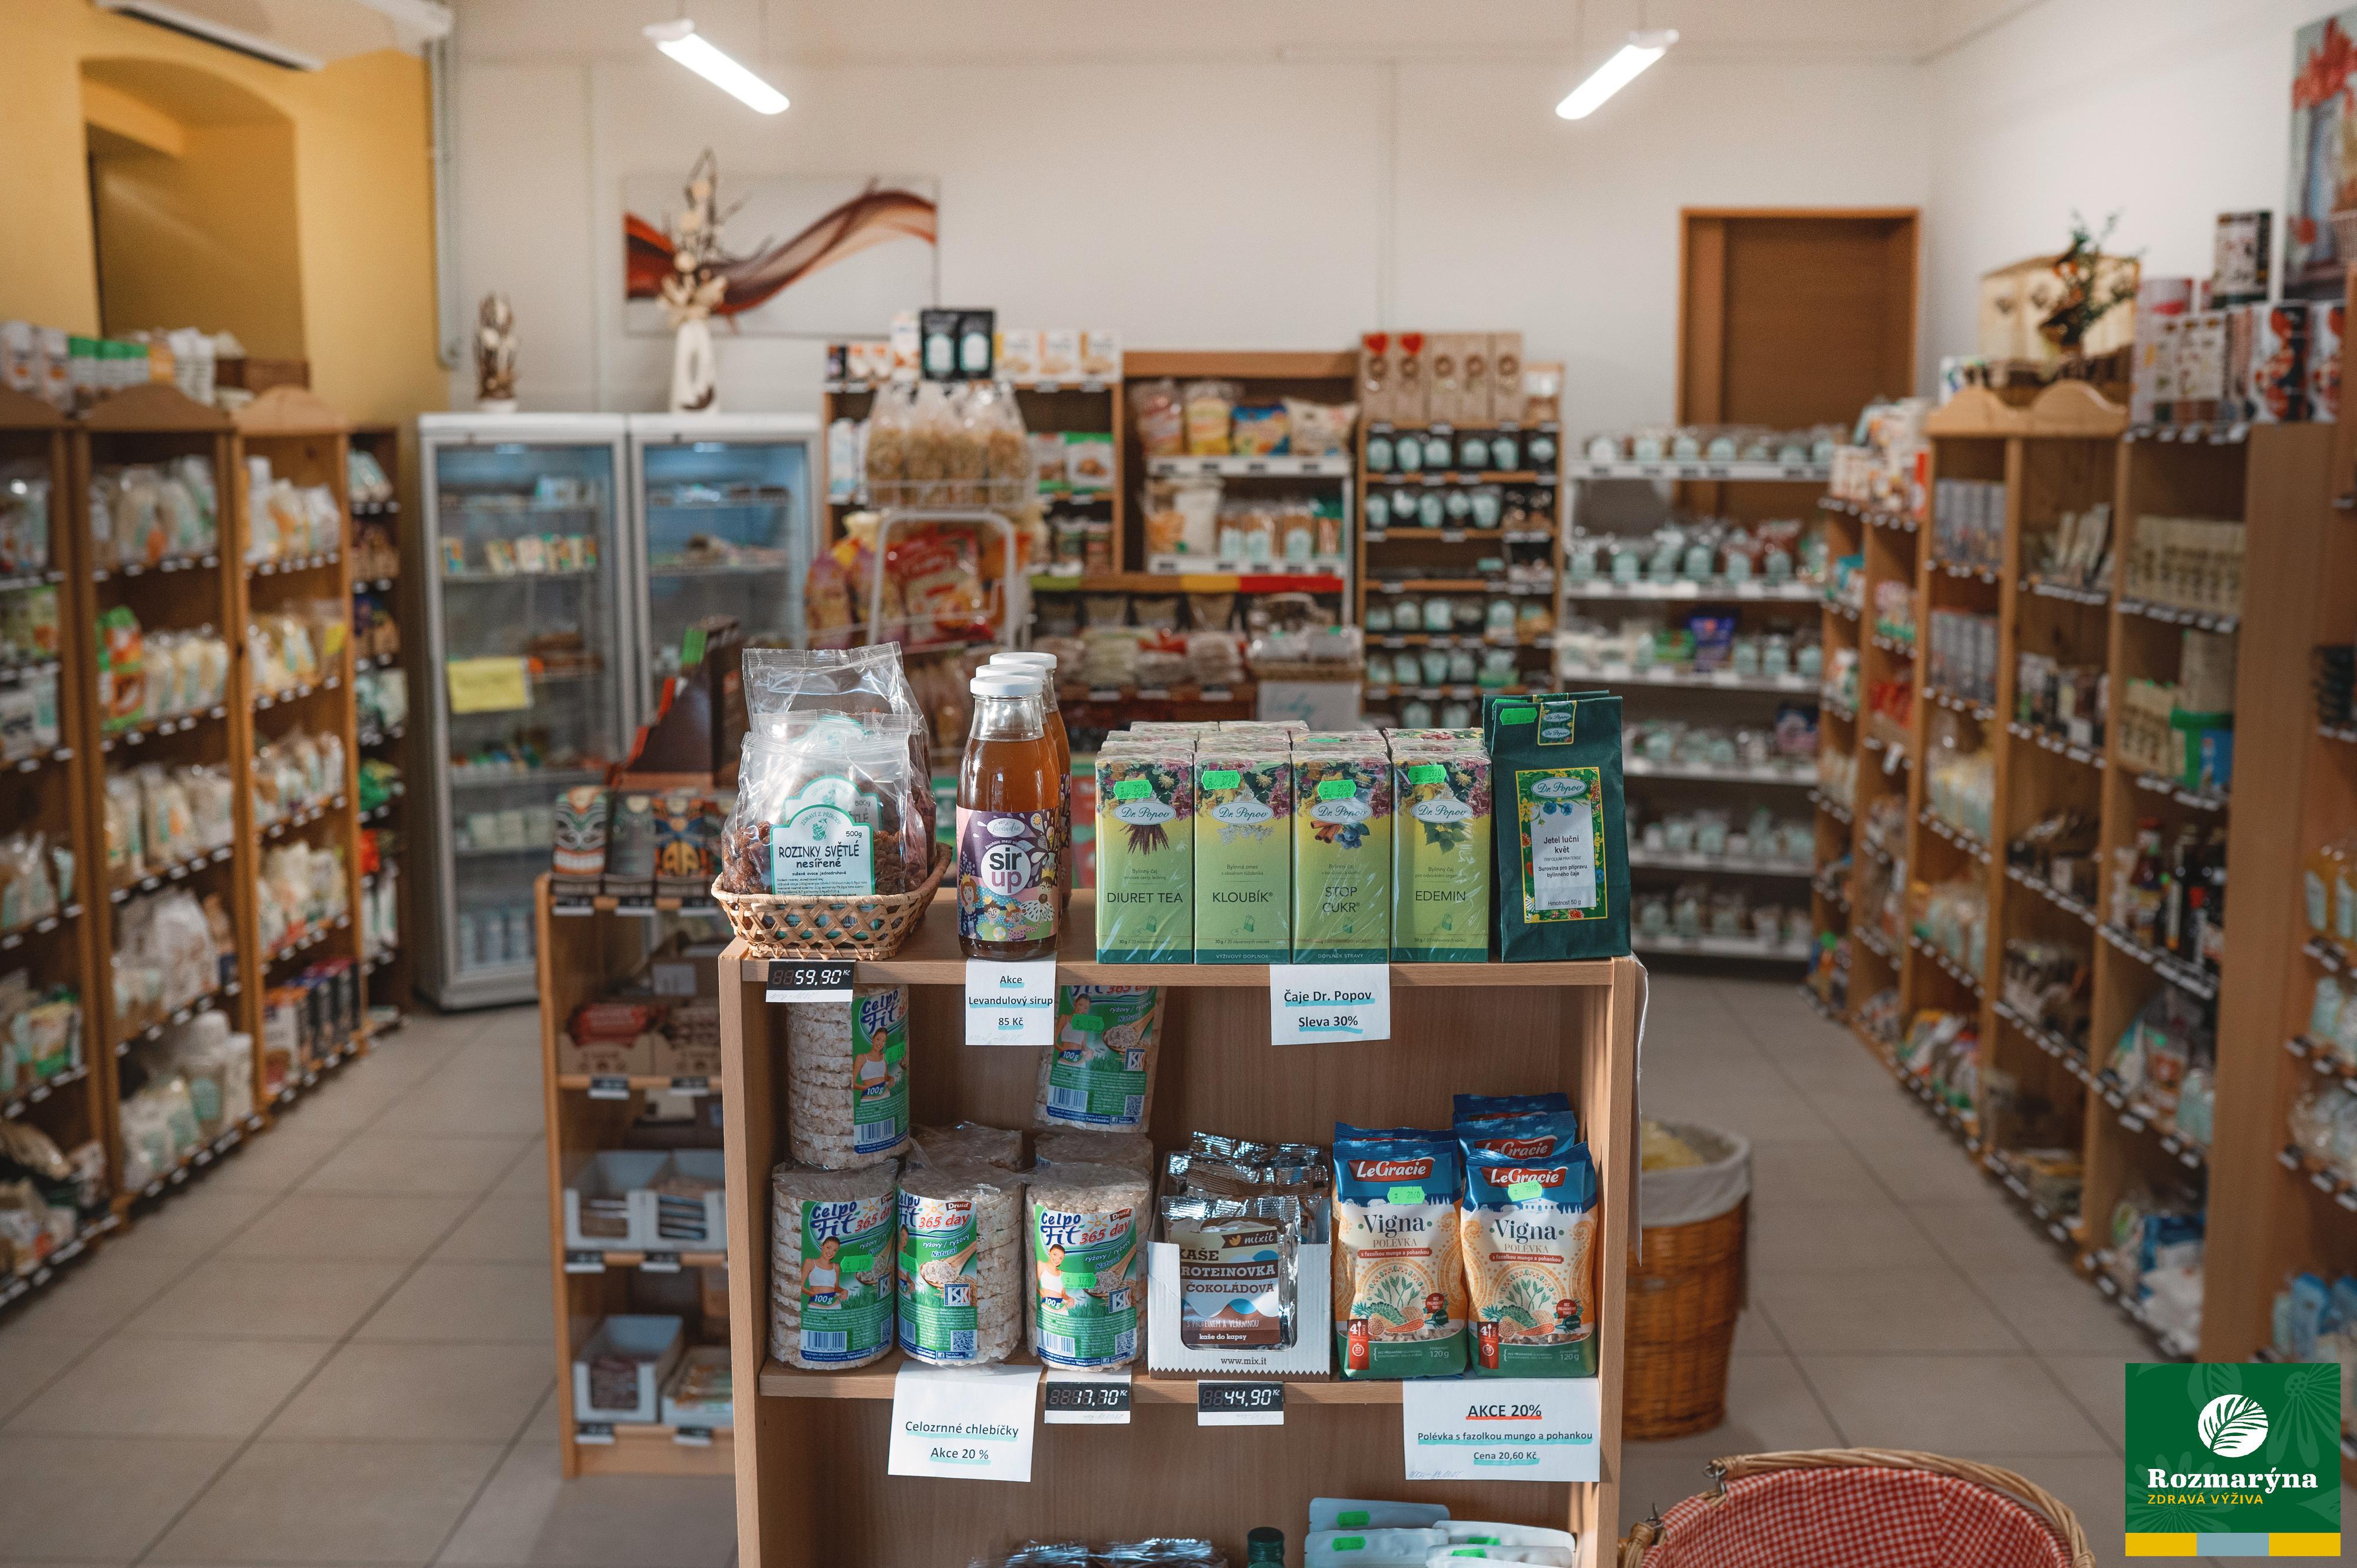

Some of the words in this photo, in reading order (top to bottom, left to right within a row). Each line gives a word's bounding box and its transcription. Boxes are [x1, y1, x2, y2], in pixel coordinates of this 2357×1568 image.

[1537, 783, 1550, 793] Dr.
[1553, 781, 1582, 794] Popov
[1121, 807, 1135, 818] Dr.
[1139, 807, 1170, 821] Popov
[1219, 807, 1233, 818] Dr.
[1236, 807, 1268, 821] Popov
[1318, 806, 1332, 816] Dr.
[1336, 805, 1367, 820] Popov
[1418, 805, 1432, 816] Dr.
[1435, 804, 1467, 819] Popov
[1544, 836, 1560, 844] Jetel
[1562, 834, 1579, 843] luční
[779, 846, 821, 859] ROZINKY
[825, 840, 859, 857] SVĚTLÉ
[796, 858, 841, 868] nesířené
[989, 847, 1022, 870] sir
[991, 871, 1022, 894] up
[1107, 892, 1154, 903] DIURET
[1157, 892, 1183, 903] TEA
[1325, 886, 1358, 897] STOP
[1415, 890, 1465, 901] EDEMIN
[795, 969, 842, 986] 59,90
[999, 975, 1022, 983] Akce
[969, 996, 1027, 1006] Levandulový
[1030, 996, 1053, 1006] sirup
[1284, 989, 1309, 1004] Čaje
[1313, 991, 1331, 1001] Dr.
[1334, 990, 1372, 1003] Popov
[998, 1017, 1009, 1026] 85
[1012, 1017, 1024, 1026] Kč
[1298, 1016, 1329, 1028] Sleva
[1333, 1015, 1358, 1026] 30%
[1062, 1050, 1079, 1062] 100g
[867, 1085, 884, 1095] 100g
[1356, 1161, 1427, 1178] LeGracie
[1491, 1168, 1559, 1184] LeGracie
[854, 1212, 878, 1233] 365
[918, 1216, 942, 1229] 365
[945, 1214, 971, 1227] day
[1362, 1214, 1425, 1238] Vigna
[1080, 1228, 1107, 1246] 365
[1110, 1219, 1131, 1237] day
[1244, 1232, 1274, 1245] mixit
[1494, 1219, 1557, 1245] Vigna
[1373, 1237, 1417, 1248] POLÉVKA
[1504, 1242, 1549, 1253] POLÉVKA
[931, 1246, 958, 1258] Natural
[1181, 1265, 1276, 1277] ROTEINOVKA
[1186, 1281, 1275, 1294] ČOKOLÁDOVÁ
[814, 1294, 833, 1305] 100g
[1044, 1298, 1061, 1309] 100g
[1193, 1319, 1220, 1328] PROTEINEM
[1229, 1318, 1259, 1328] VLÁKNINOU
[1349, 1323, 1358, 1335] 4
[1480, 1326, 1488, 1336] 4
[1221, 1356, 1267, 1365] www.mix.it
[1077, 1389, 1120, 1407] 17,70
[1224, 1389, 1272, 1407] 44,90
[1467, 1404, 1506, 1417] AKCE
[1511, 1404, 1542, 1417] 20%
[905, 1421, 962, 1434] Celozrnné
[966, 1424, 1019, 1438] chlebíčky
[1418, 1432, 1453, 1441] Polévka
[1463, 1431, 1501, 1440] fazolkou
[1504, 1433, 1536, 1442] mungo
[1546, 1431, 1593, 1442] pohankou
[930, 1447, 958, 1458] Akce
[962, 1448, 976, 1459] 20
[979, 1449, 989, 1460] %
[1474, 1452, 1496, 1460] Cena
[1498, 1452, 1524, 1461] 20,60
[1526, 1451, 1537, 1460] Kč
